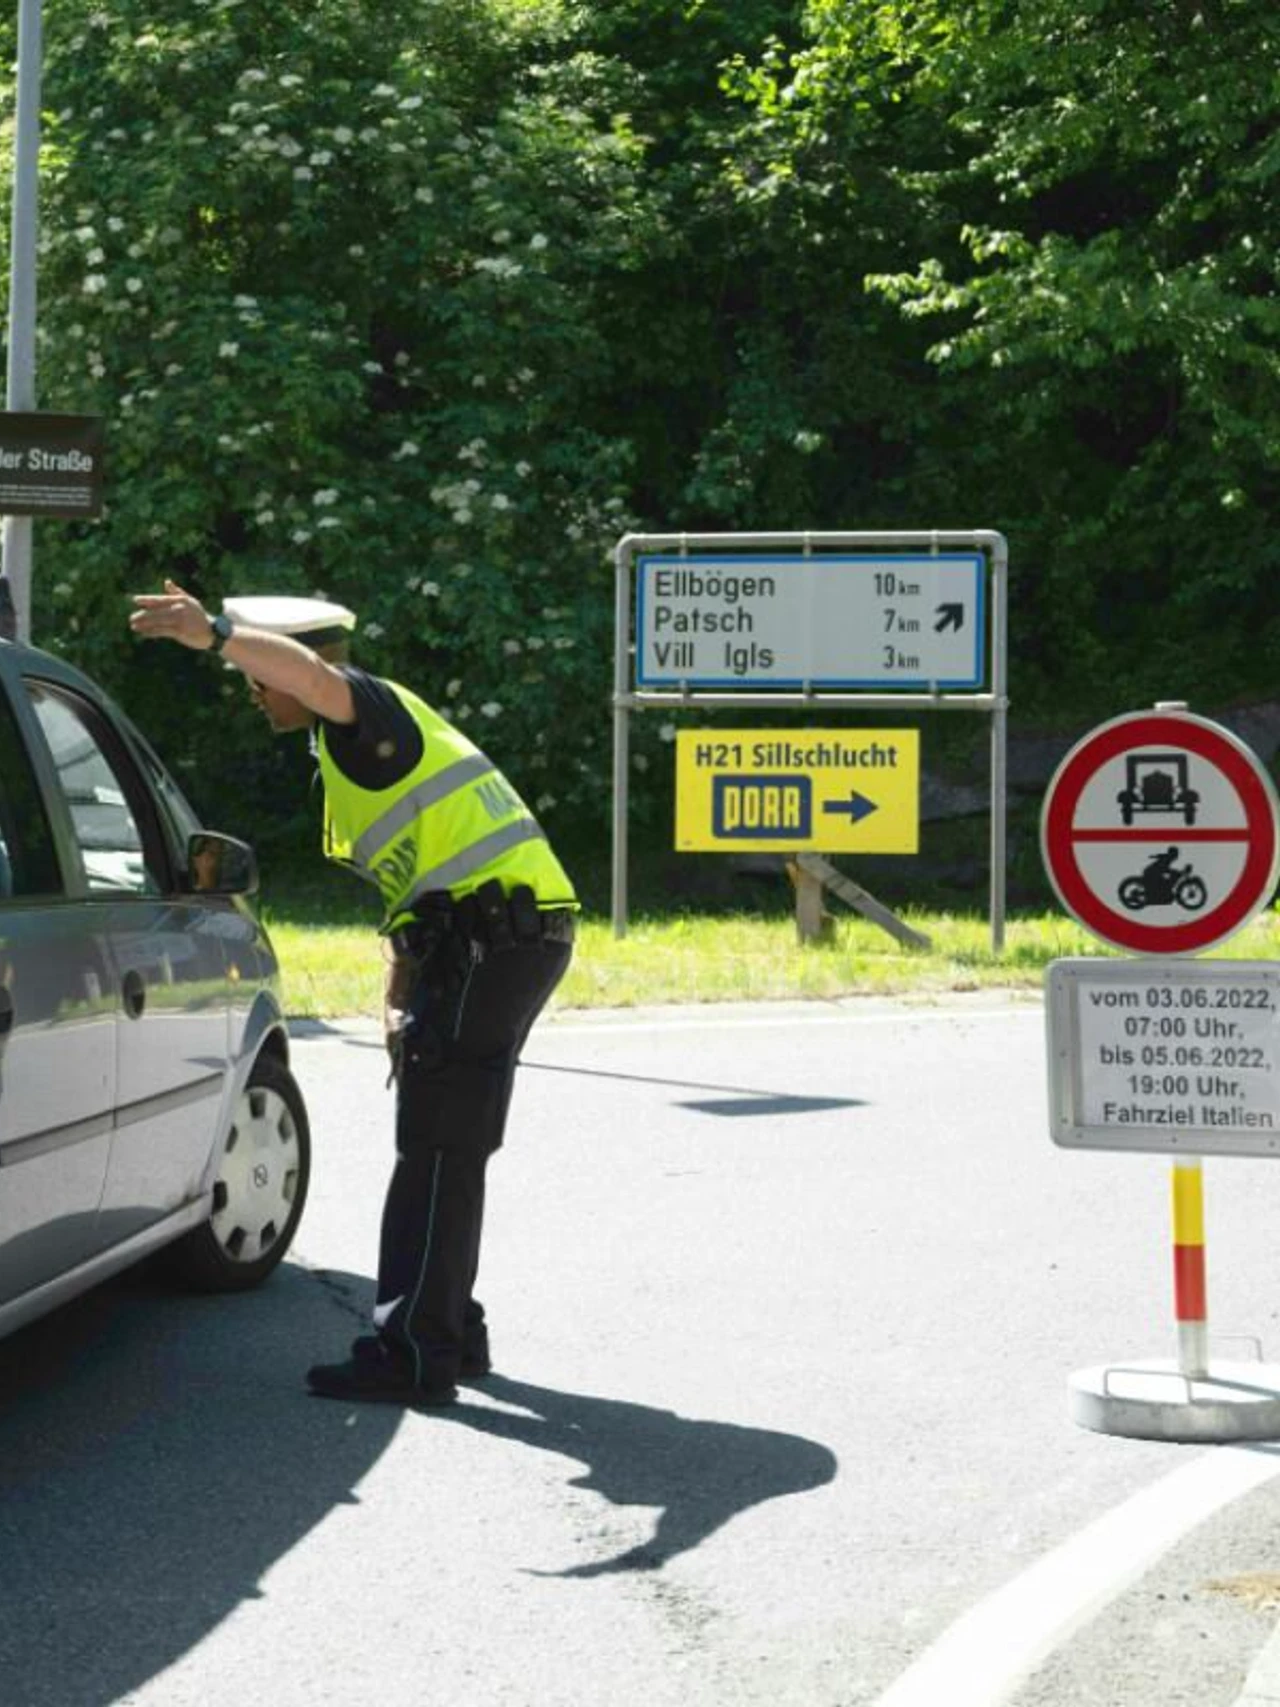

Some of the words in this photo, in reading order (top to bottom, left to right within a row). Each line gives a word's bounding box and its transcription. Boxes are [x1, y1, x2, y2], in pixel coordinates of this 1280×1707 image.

[28, 448, 93, 472] Straße
[654, 570, 775, 603] Ellbögen
[874, 573, 896, 597] 10
[898, 579, 921, 597] km
[654, 607, 753, 633] Patsch
[884, 609, 896, 633] 7
[898, 615, 920, 633] km
[654, 643, 694, 668] Vill
[725, 643, 774, 675] Igls
[883, 646, 895, 668] 3
[898, 652, 920, 669] km
[695, 744, 743, 768] H21
[752, 743, 897, 768] Sillschlucht
[1089, 991, 1140, 1007] vom
[1124, 1017, 1187, 1038] 07:00
[1099, 1046, 1135, 1066] bis
[1128, 1075, 1189, 1095] 19:00
[1103, 1102, 1195, 1125] Fahrziel
[1202, 1104, 1273, 1128] Italien
